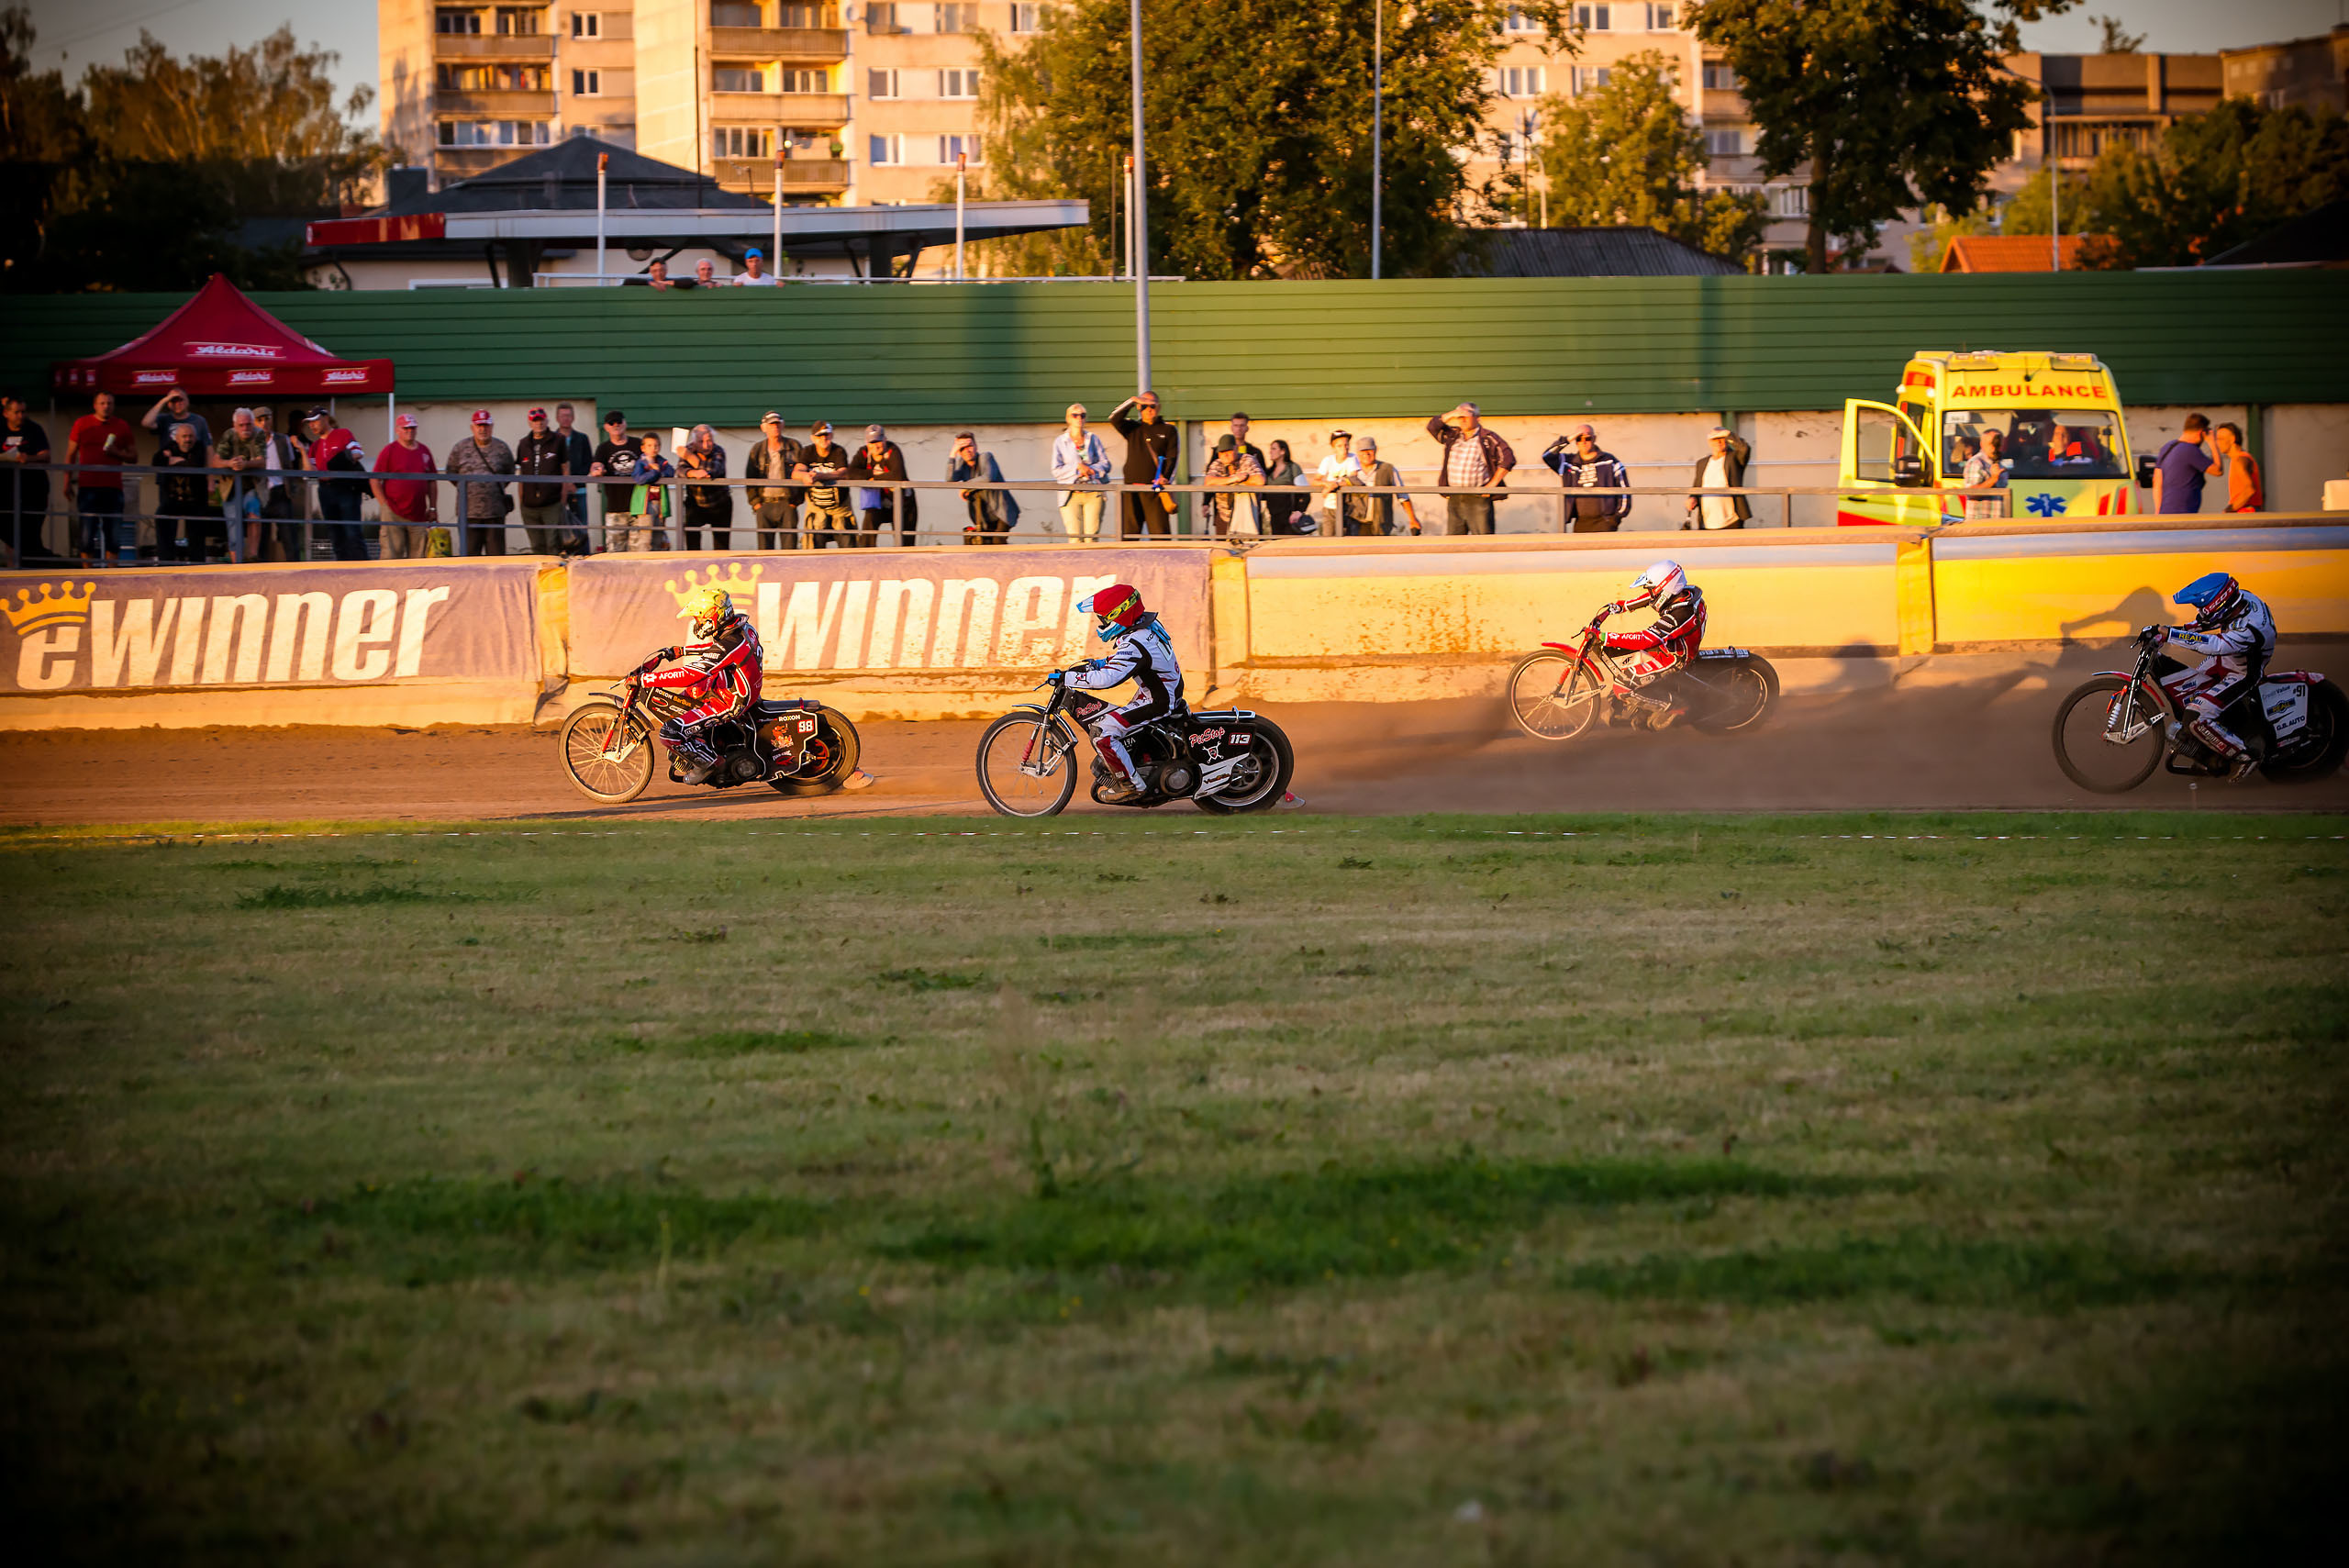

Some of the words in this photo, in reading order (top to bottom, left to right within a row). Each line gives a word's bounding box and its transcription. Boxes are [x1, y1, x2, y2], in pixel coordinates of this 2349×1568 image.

[195, 345, 275, 356] Aldaris
[1952, 384, 2108, 398] AMBULANCE
[2209, 580, 2236, 611] SCOTT
[659, 670, 685, 680] AFORTI
[655, 688, 674, 699] ROXON
[2276, 685, 2291, 695] Value
[1075, 701, 1102, 717] PitStop
[778, 714, 801, 722] ROXON
[2288, 716, 2305, 727] AUTO
[798, 720, 814, 733] 98
[1189, 727, 1226, 748] PitStop
[1230, 734, 1251, 744] 113
